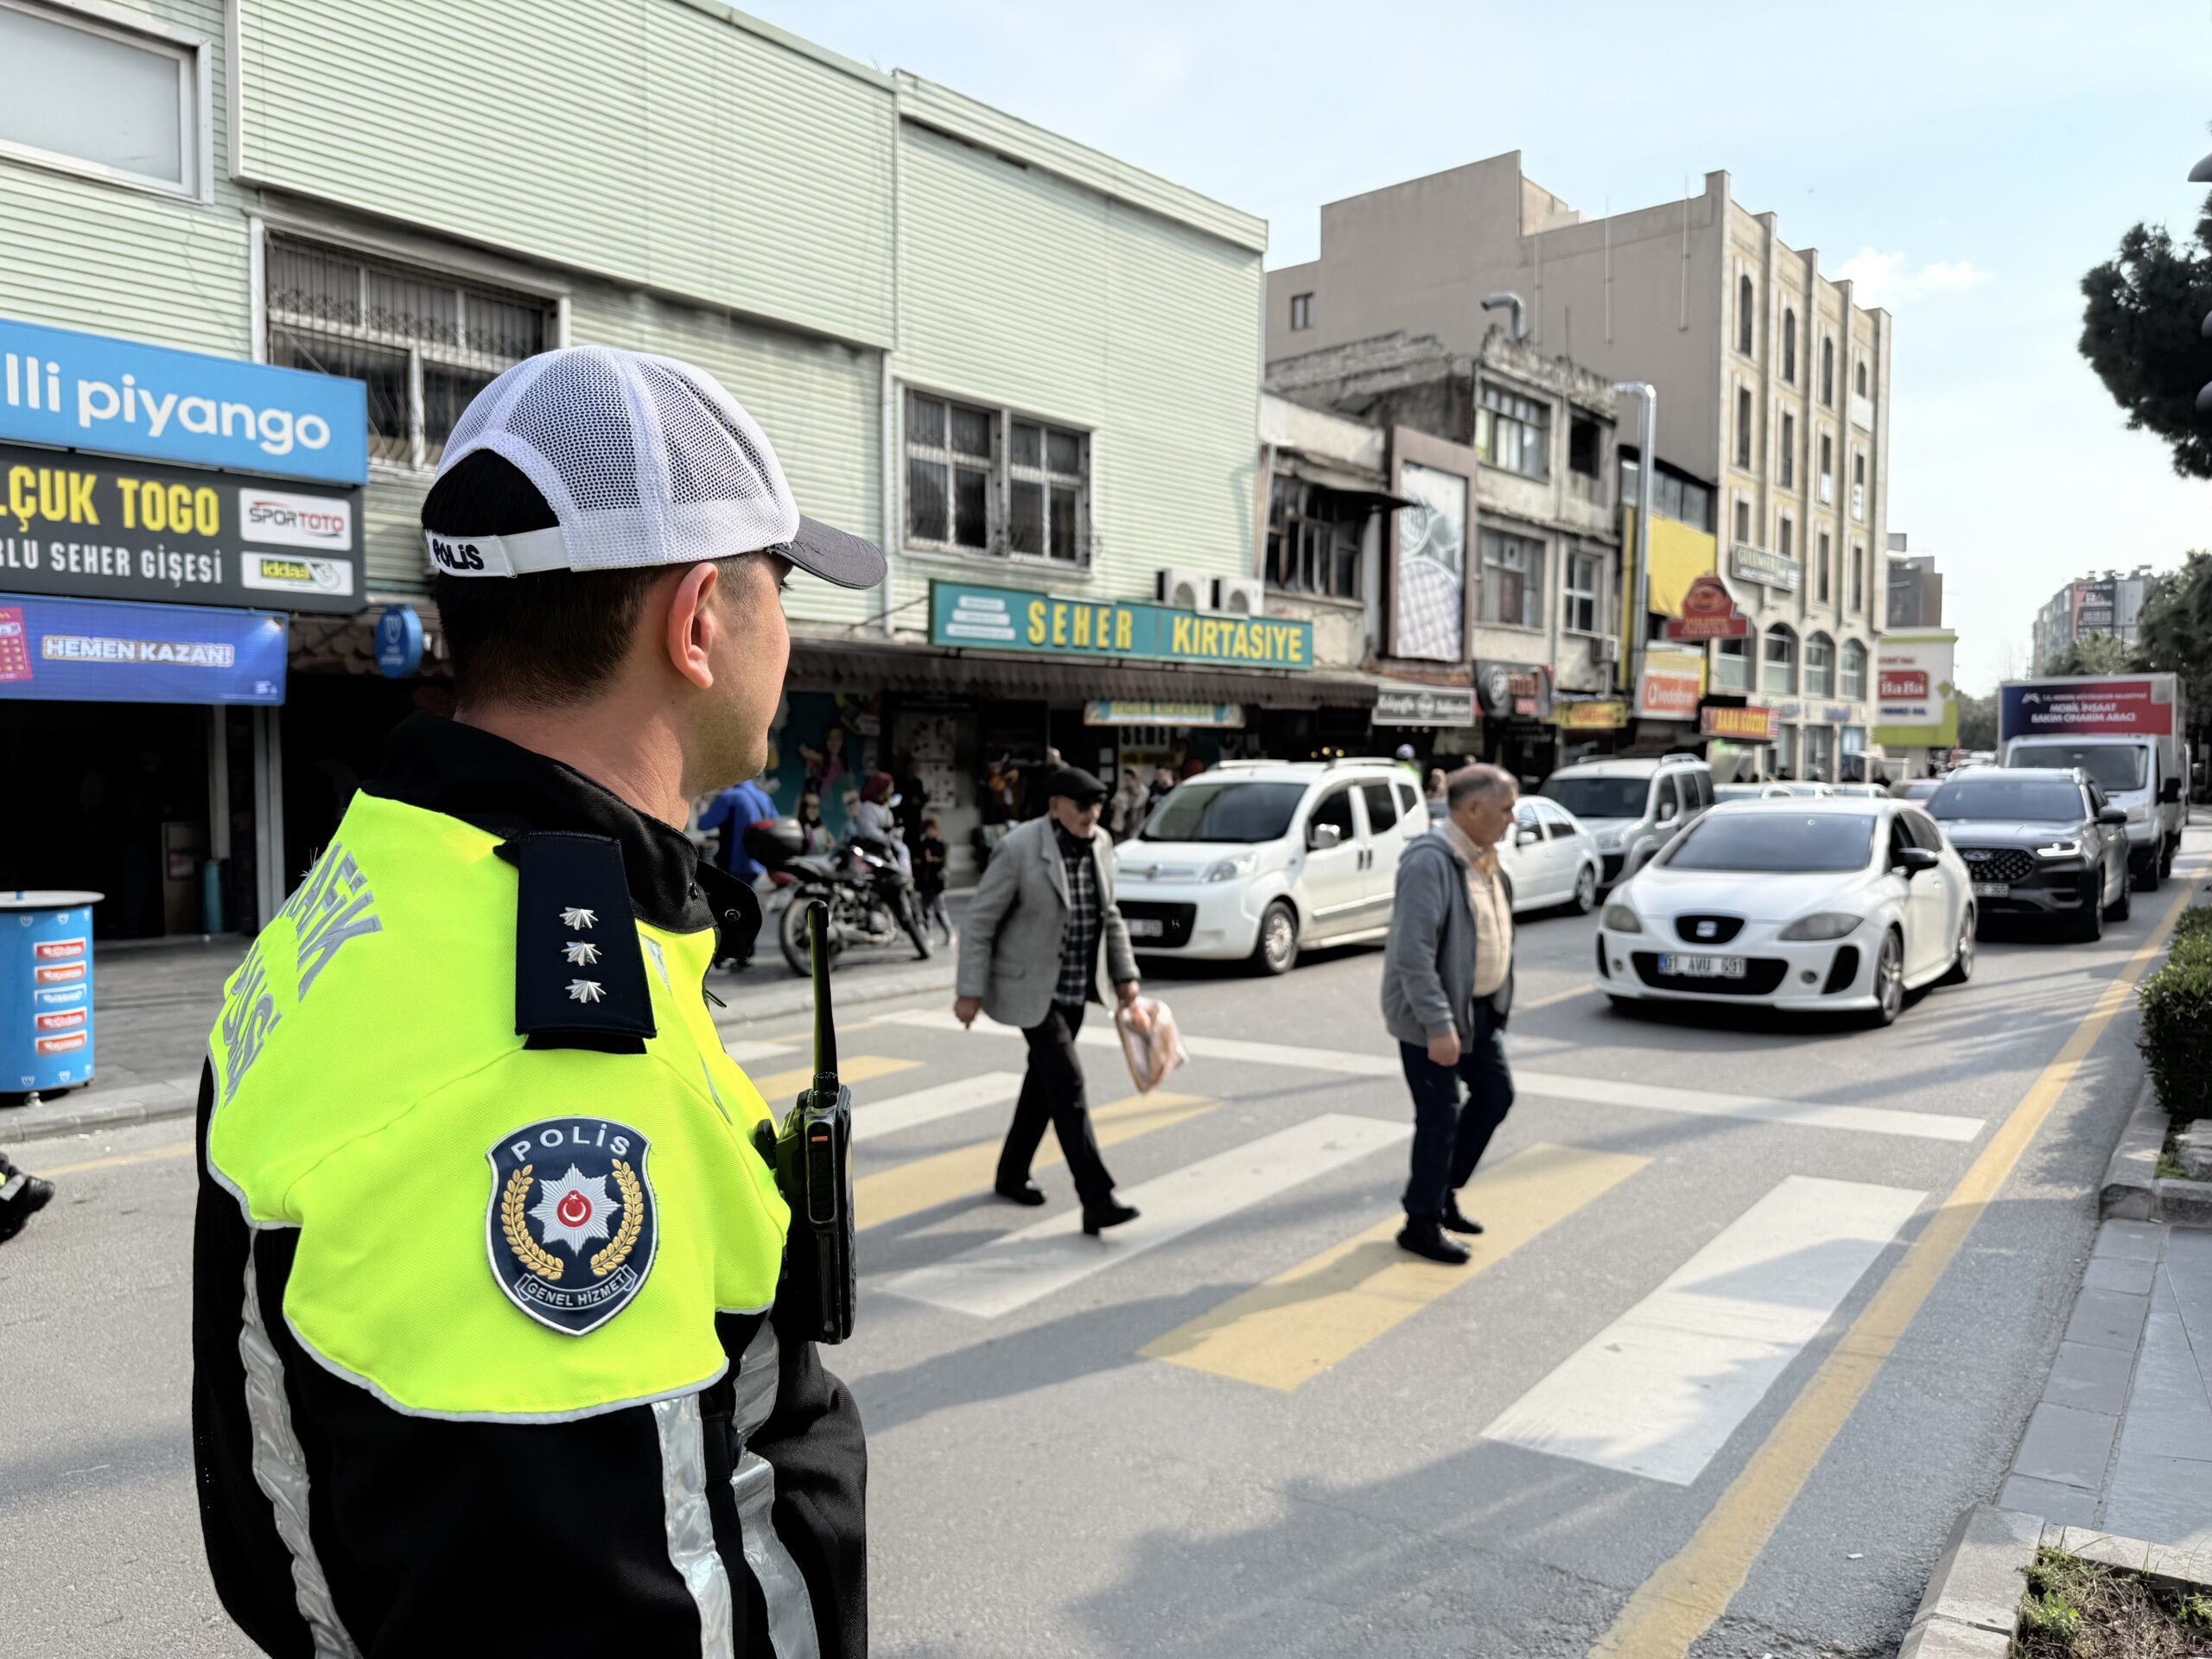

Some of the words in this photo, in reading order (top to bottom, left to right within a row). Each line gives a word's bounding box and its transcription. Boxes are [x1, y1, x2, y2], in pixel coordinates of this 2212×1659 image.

[78, 373, 331, 456] piyango
[117, 477, 219, 537] TOGO
[50, 542, 131, 576] SEHER
[140, 543, 222, 588] GİŞESİ
[262, 558, 311, 581] iddaa
[1027, 601, 1133, 651] SEHER
[46, 638, 136, 660] HEMEN
[511, 1123, 630, 1162] POLİS
[527, 1282, 574, 1306] GENEL
[577, 1273, 626, 1306] HİZMET
